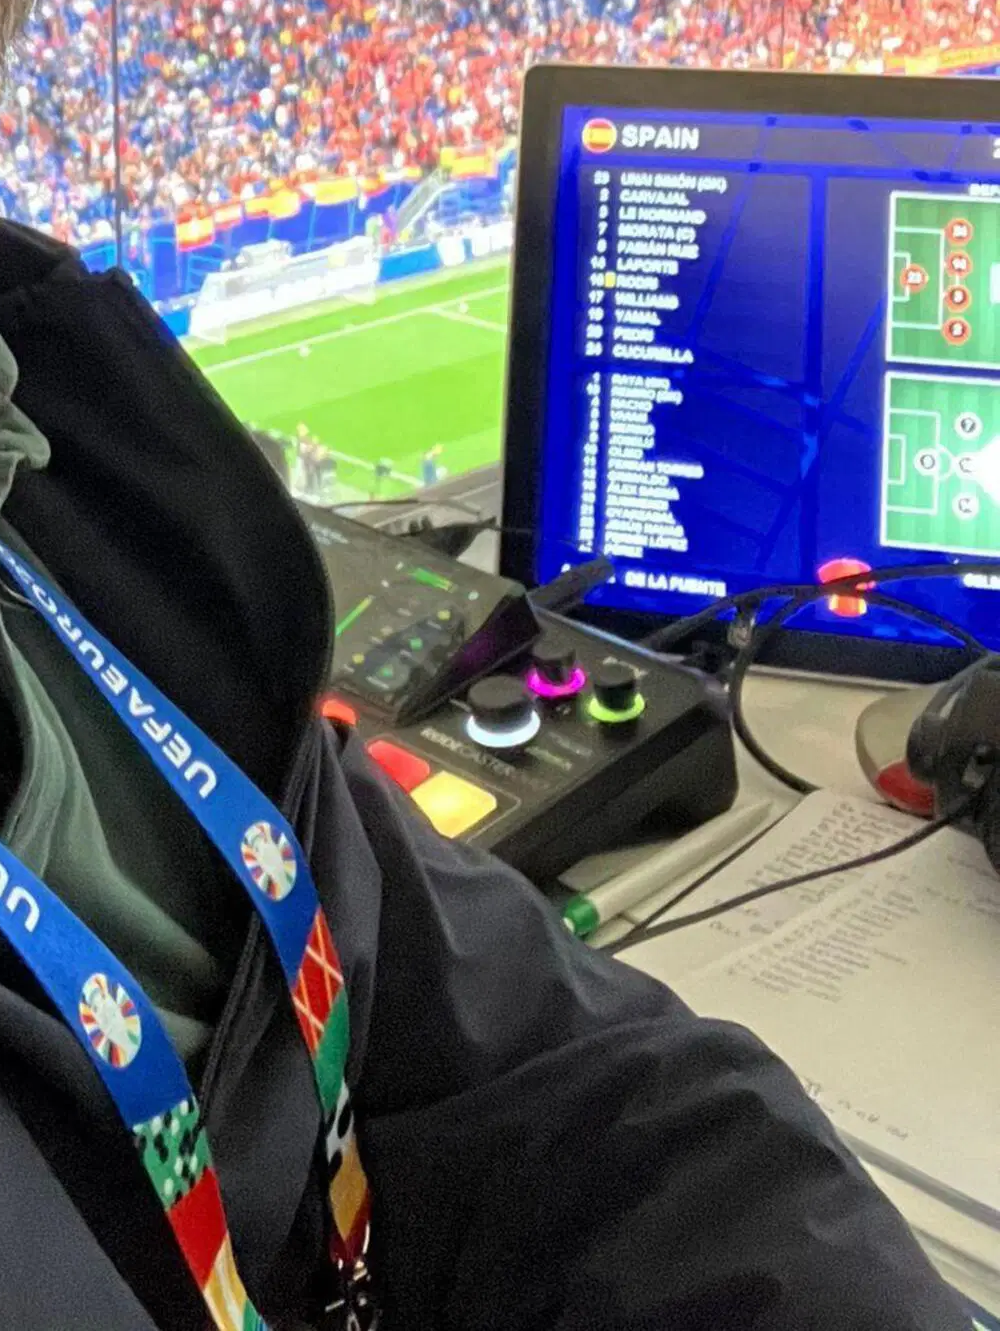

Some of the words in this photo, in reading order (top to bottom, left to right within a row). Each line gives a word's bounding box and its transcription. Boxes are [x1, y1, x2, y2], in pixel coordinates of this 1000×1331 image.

[621, 123, 700, 151] SPAIN
[647, 573, 668, 591] LA
[668, 574, 727, 598] FUENTE
